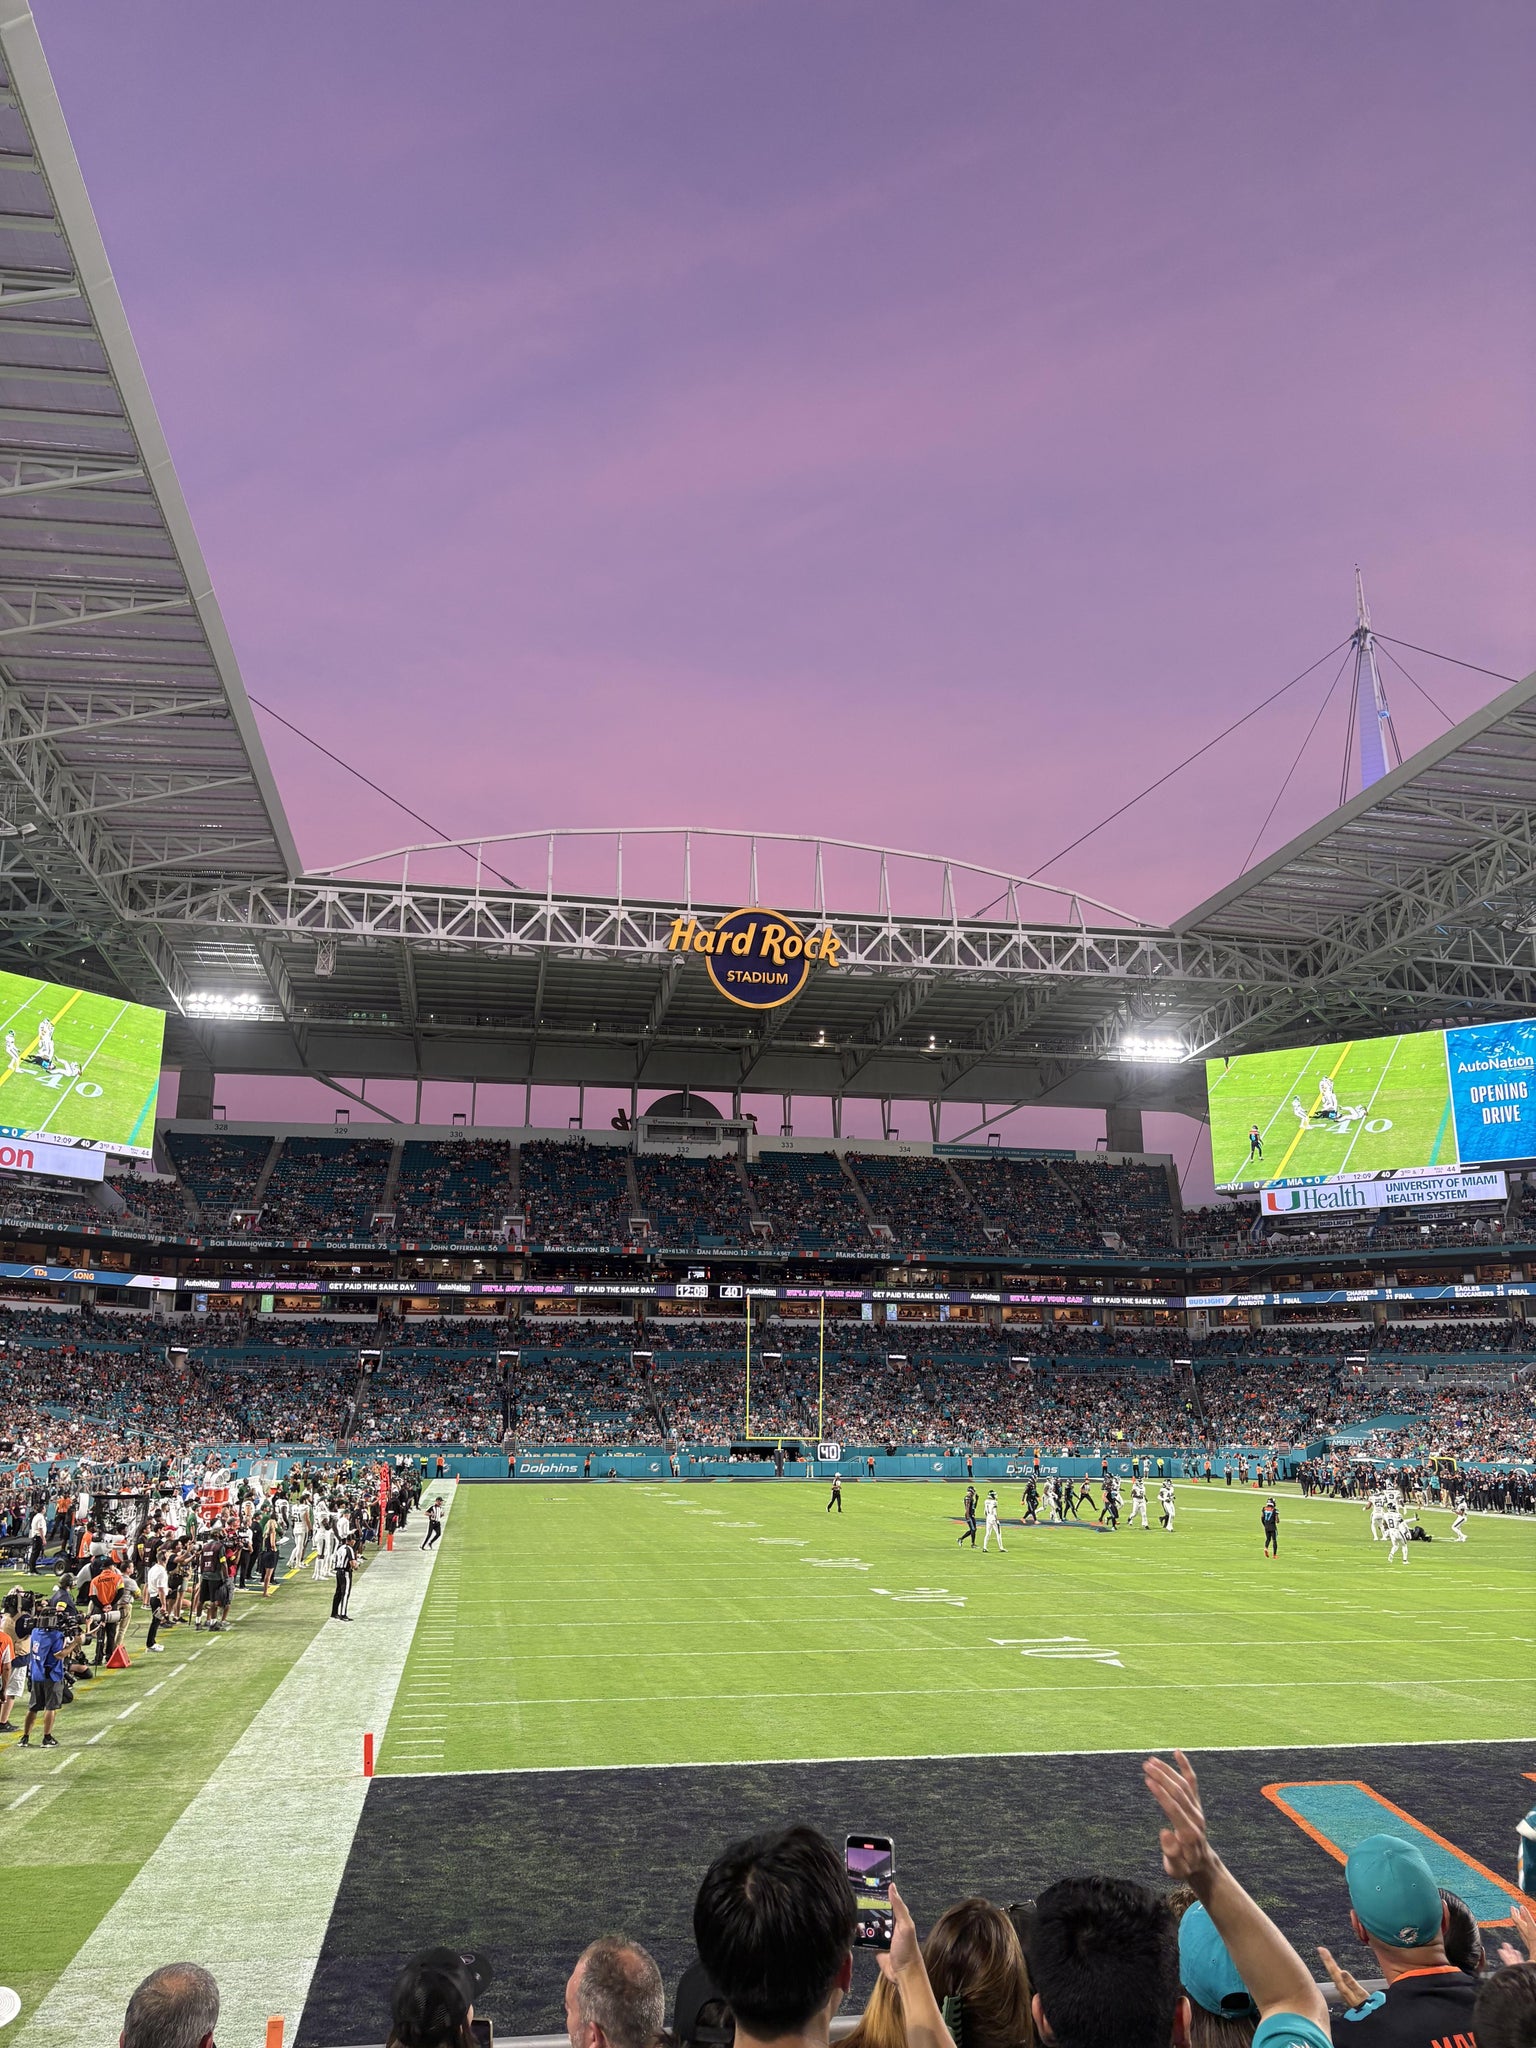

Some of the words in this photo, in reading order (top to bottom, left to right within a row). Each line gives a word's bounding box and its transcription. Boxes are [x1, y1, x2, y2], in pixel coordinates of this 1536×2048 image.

[668, 918, 756, 957] Hard
[760, 924, 841, 967] Rock
[727, 970, 788, 985] STADIUM
[1457, 1055, 1534, 1073] AutoNation
[1470, 1081, 1528, 1104] OPENING
[1482, 1105, 1522, 1124] DRIVE
[334, 1127, 348, 1135] 329
[11, 1128, 18, 1137] 0
[54, 1135, 72, 1144] 12:09
[81, 1139, 90, 1148] 40
[141, 1149, 149, 1157] 44
[1353, 1172, 1371, 1180] 12:09
[1227, 1182, 1243, 1191] NYJ
[1286, 1178, 1303, 1186] MIA
[1386, 1178, 1443, 1192] UNIVERSITY
[1446, 1177, 1459, 1187] OF
[1463, 1175, 1498, 1187] MIAMI
[1387, 1192, 1425, 1204] HEALTH
[1427, 1189, 1468, 1200] SYSTEM
[57, 1224, 69, 1232] 67
[168, 1235, 177, 1243] 78
[34, 1269, 47, 1277] TDs
[74, 1272, 94, 1280] LONG
[378, 1283, 399, 1291] SAME
[678, 1287, 706, 1296] 12:09
[725, 1287, 738, 1296] 40
[821, 1446, 837, 1458] 40
[520, 1463, 578, 1475] Dolphins
[1264, 1510, 1273, 1521] 17
[1388, 1518, 1394, 1528] 8
